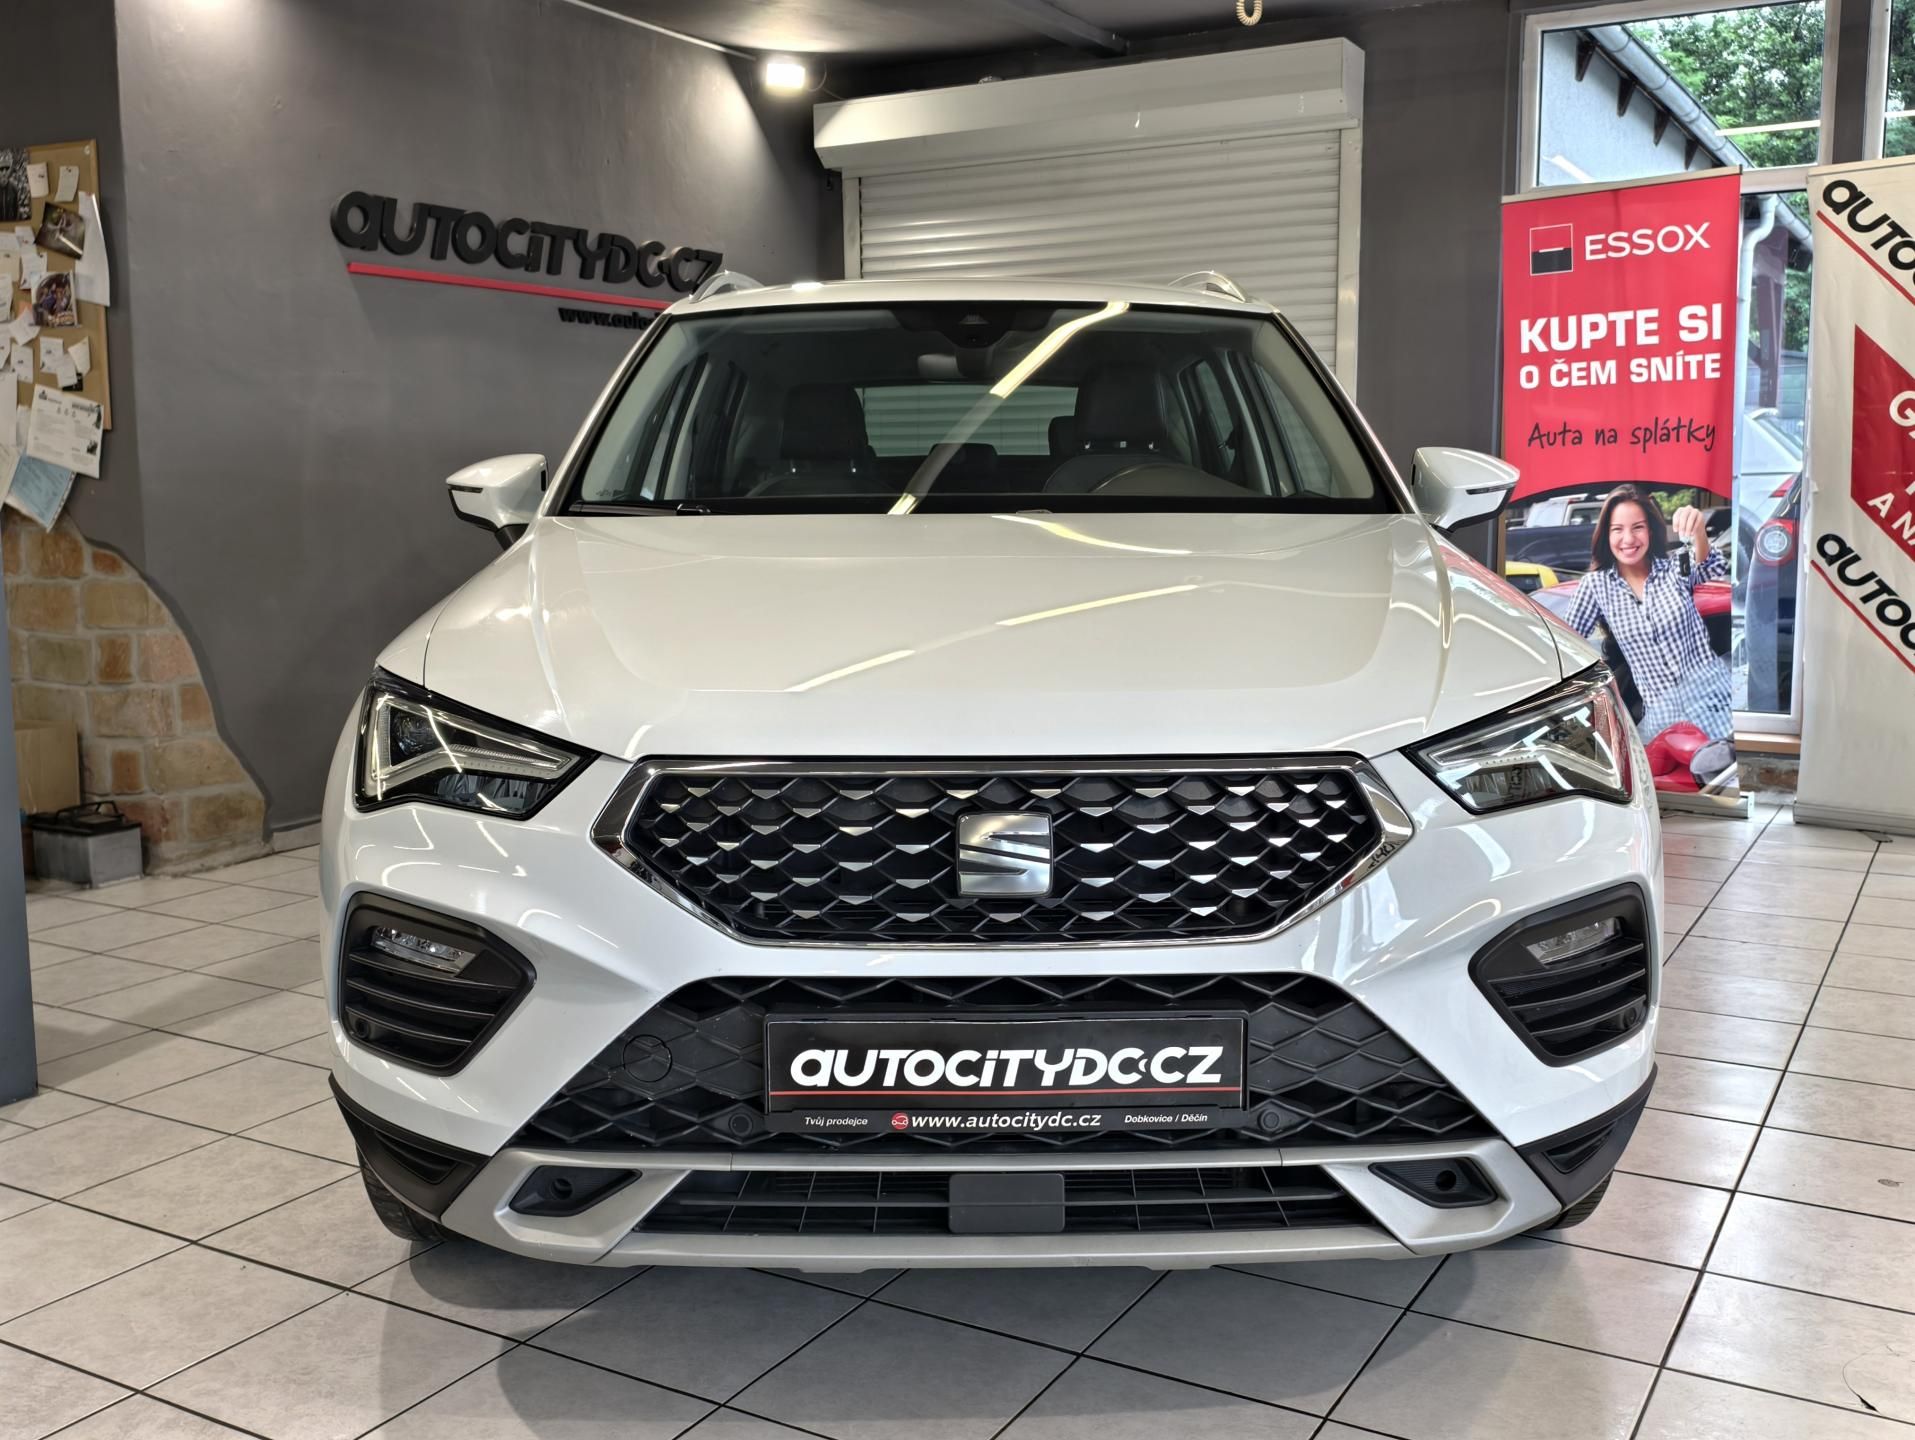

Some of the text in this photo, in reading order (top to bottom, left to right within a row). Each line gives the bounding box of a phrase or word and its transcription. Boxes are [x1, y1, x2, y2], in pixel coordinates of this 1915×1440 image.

[1585, 222, 1711, 260] ESSOX
[1520, 303, 1722, 353] KUPTE SI
[1519, 350, 1721, 389] O ČEM SNÍTE
[1528, 416, 1716, 453] Auta na splátky
[1867, 492, 1895, 519] A
[805, 1117, 868, 1127] Tvůj prodejce
[912, 1112, 1102, 1131] www.autocitydc.cz
[1125, 1115, 1173, 1123] Dobkovice
[1181, 1114, 1208, 1122] Děčín
